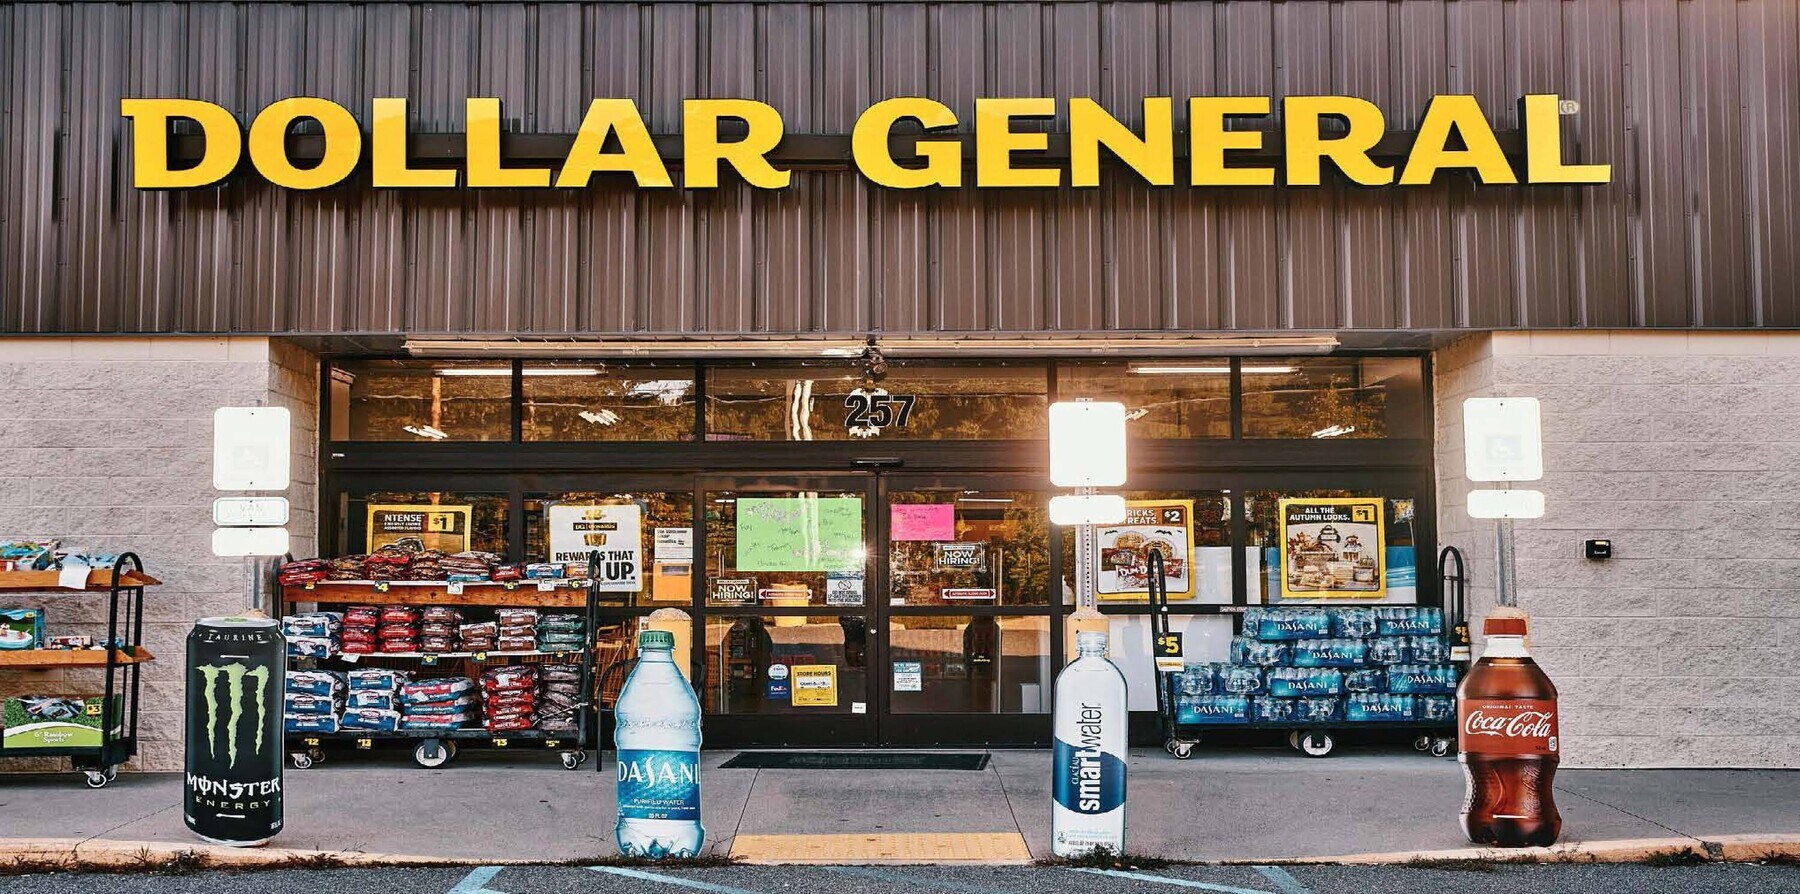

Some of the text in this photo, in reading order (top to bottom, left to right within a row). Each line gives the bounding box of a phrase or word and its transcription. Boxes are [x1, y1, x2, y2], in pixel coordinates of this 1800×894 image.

[120, 94, 1612, 191] DOLLAR GENERAL
[845, 395, 915, 427] 257
[1126, 509, 1157, 517] RICKS.
[556, 550, 634, 561] REWARS THAT
[944, 550, 974, 558] NOW
[939, 557, 980, 565] HIRING!
[606, 561, 636, 581] UP.
[718, 584, 747, 592] NOW
[712, 591, 754, 599] HIRING!
[1277, 622, 1317, 632] DASANI
[1390, 621, 1429, 630] DASANI
[208, 633, 262, 641] TAURINE
[1157, 636, 1179, 654] $5
[1312, 650, 1352, 659] DASANI
[1407, 674, 1446, 684] DASANI
[1288, 680, 1327, 691] DASANI
[1193, 704, 1233, 715] DASANI
[1362, 702, 1402, 713] DASANI
[1465, 710, 1553, 737] Coca-Cola
[618, 756, 700, 789] DASANI
[187, 771, 281, 799] MONSTER
[196, 796, 271, 810] ENERGY
